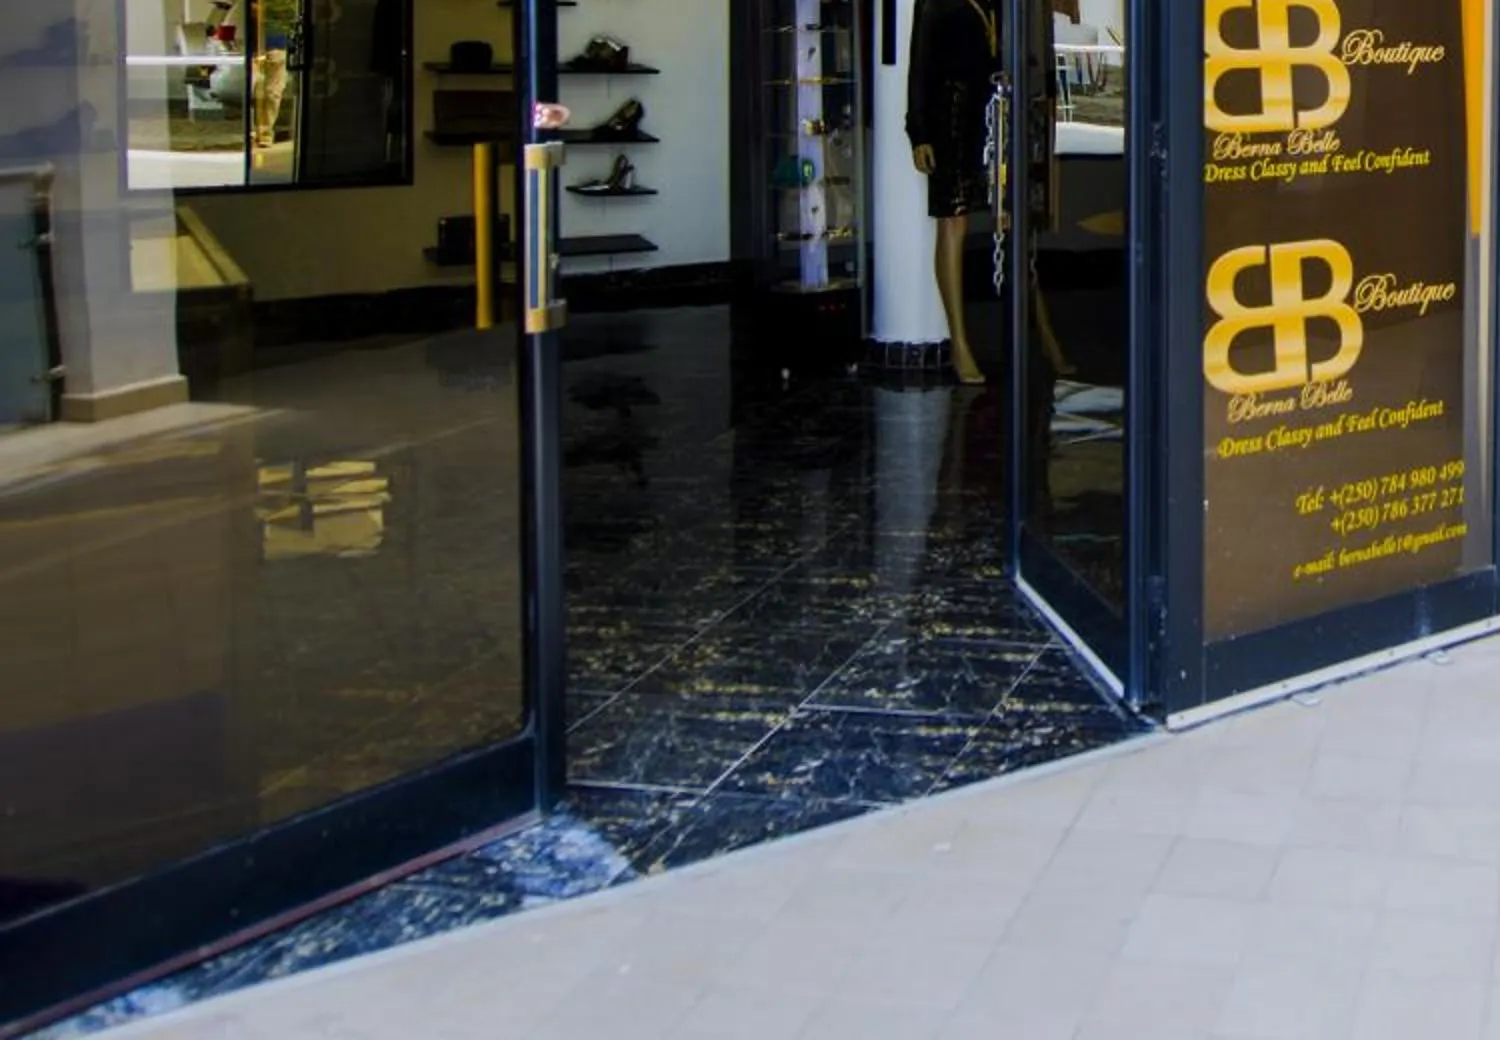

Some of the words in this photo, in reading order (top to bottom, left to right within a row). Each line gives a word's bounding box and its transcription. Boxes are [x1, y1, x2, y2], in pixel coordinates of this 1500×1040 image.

[1341, 29, 1445, 75] Boutique
[1204, 164, 1247, 183] Dress
[1251, 158, 1298, 183] Classy
[1299, 154, 1328, 174] and
[1331, 149, 1363, 173] Feel
[1364, 148, 1431, 174] Confident
[1213, 132, 1281, 161] Berna
[1286, 128, 1341, 155] Belle
[1354, 273, 1456, 316] Boutique
[1227, 393, 1295, 423] Berna
[1299, 379, 1353, 410] Belle
[1217, 435, 1262, 458] Dress
[1266, 423, 1313, 448] Classy
[1315, 413, 1346, 438] and
[1346, 407, 1377, 434] Feel
[1379, 398, 1444, 428] Confident
[1329, 478, 1379, 511] +(250)
